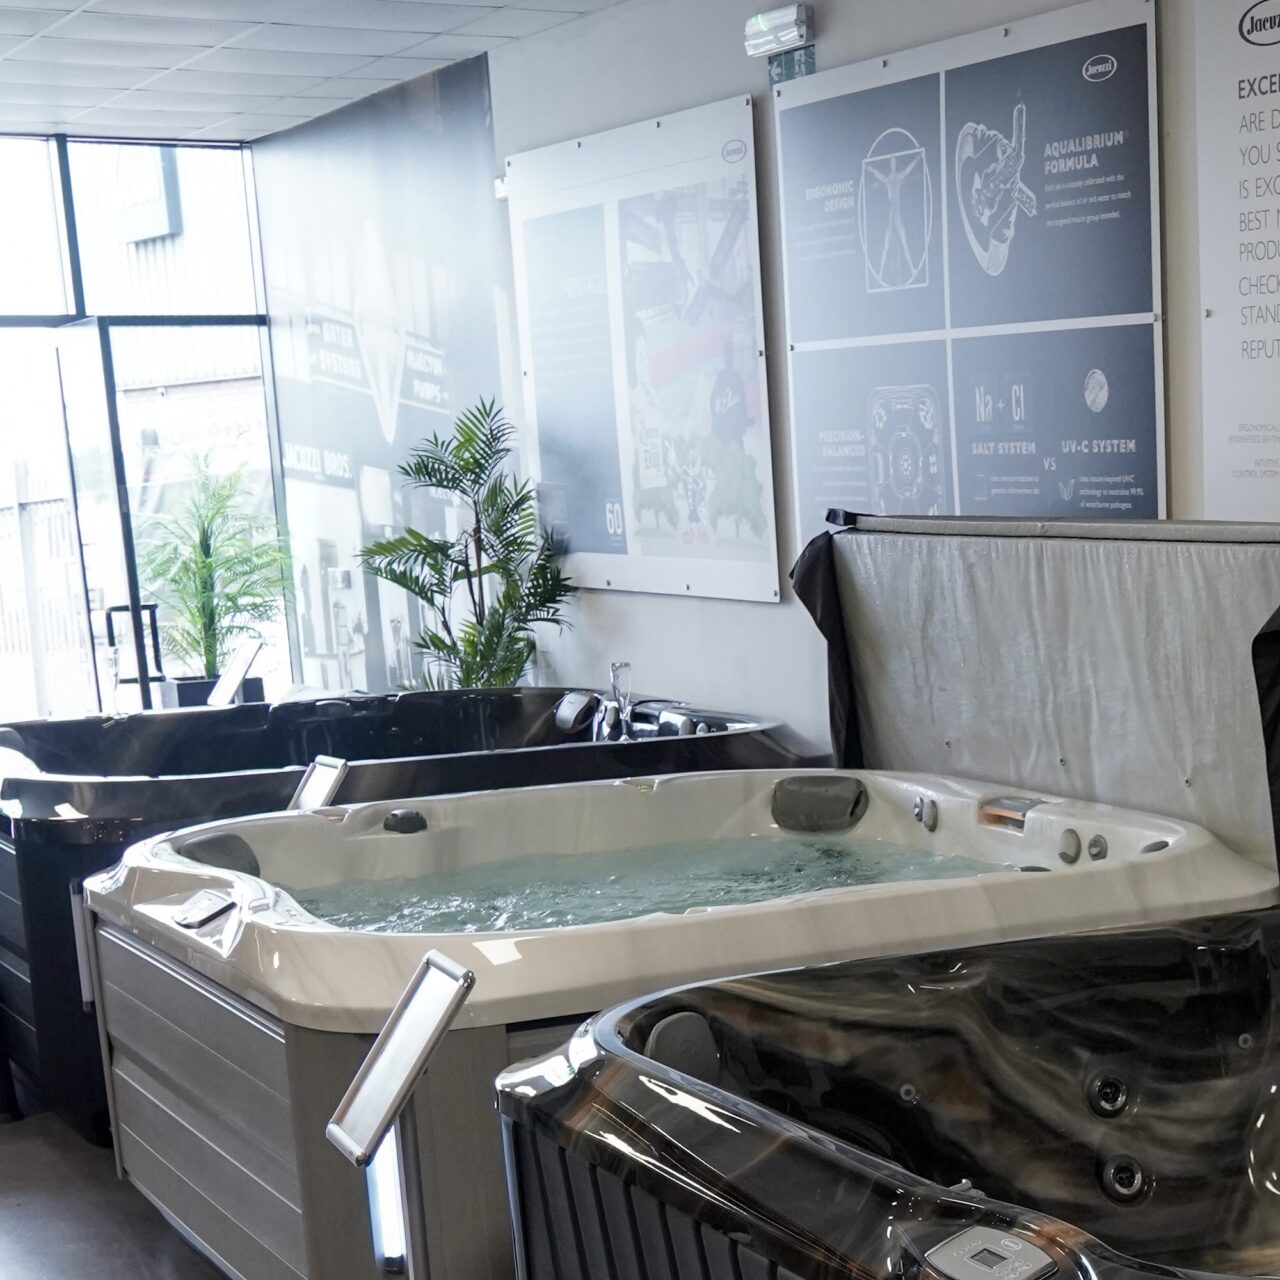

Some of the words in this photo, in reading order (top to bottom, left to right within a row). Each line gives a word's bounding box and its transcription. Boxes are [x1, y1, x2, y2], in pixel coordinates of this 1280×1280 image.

[1239, 111, 1265, 134] ARE
[1045, 154, 1099, 175] FORMULA
[1240, 144, 1270, 166] YOU
[1240, 179, 1249, 199] IS
[1240, 209, 1270, 232] BEST
[976, 386, 992, 422] Na
[1012, 384, 1024, 420] Cl
[972, 442, 994, 455] SALT
[998, 442, 1036, 454] SYSTEM
[1062, 440, 1089, 453] UV-C
[1092, 439, 1136, 453] SYSTEM
[1043, 458, 1056, 470] VS
[606, 503, 623, 535] 60
